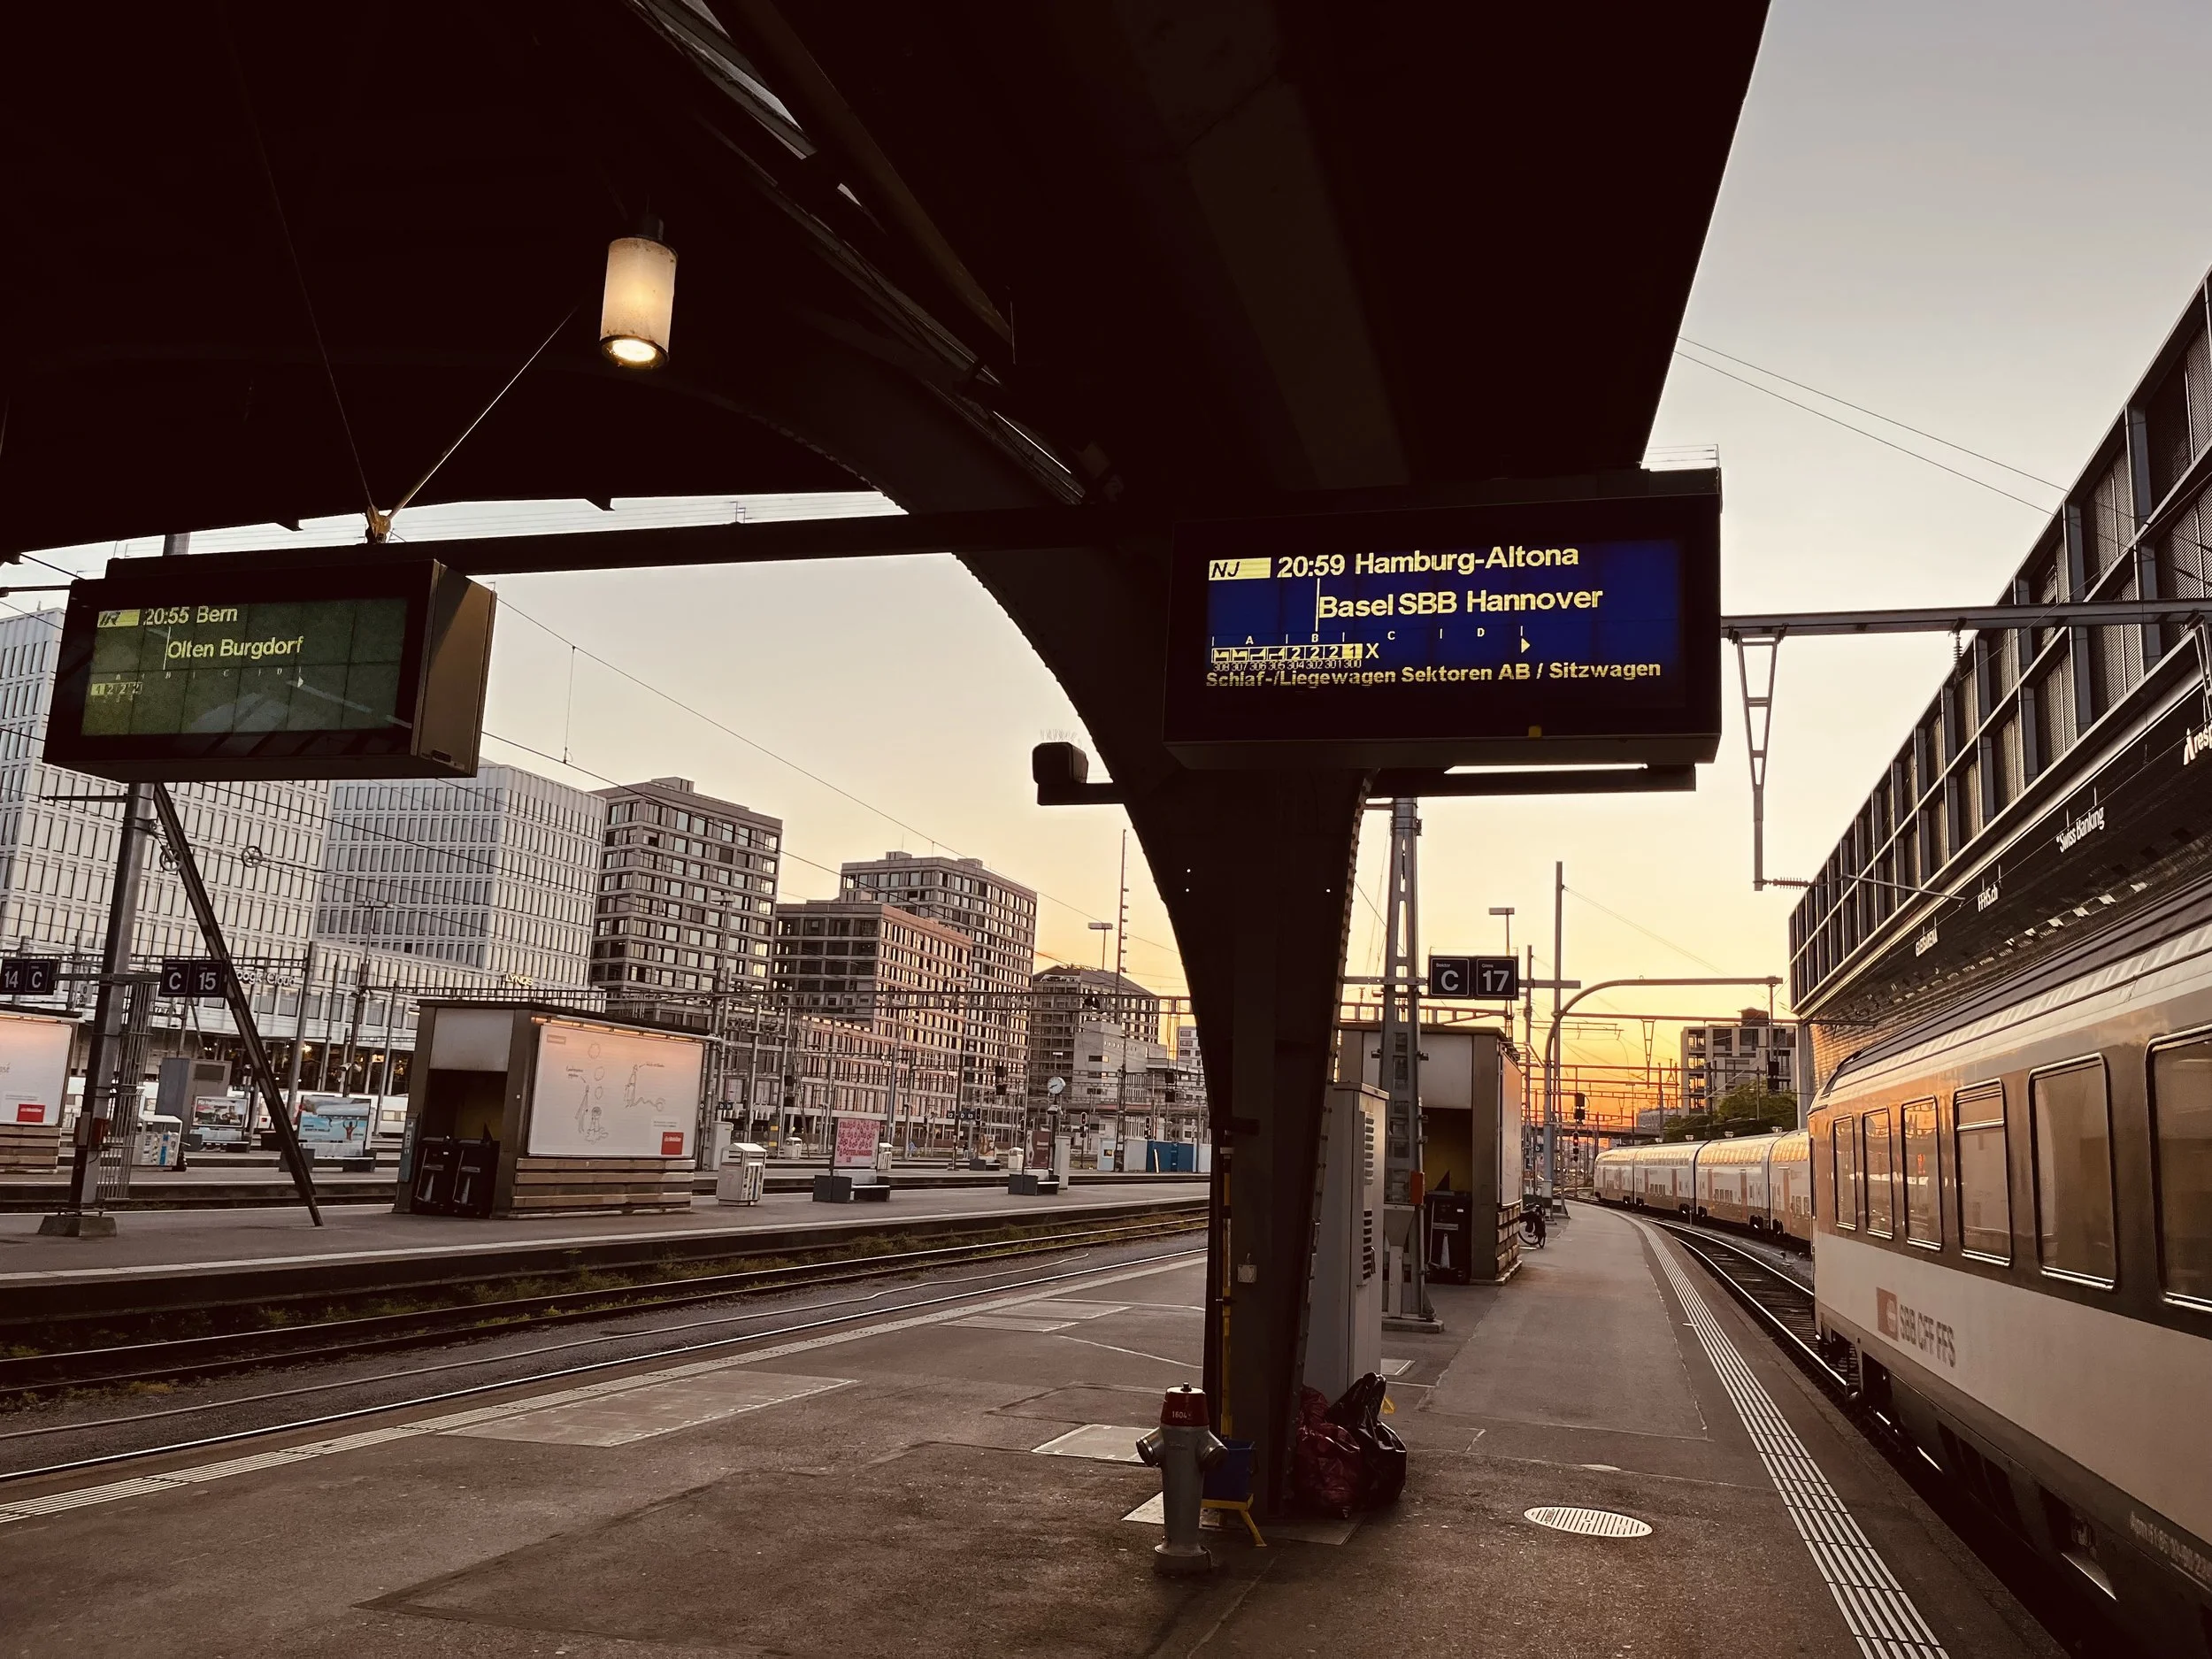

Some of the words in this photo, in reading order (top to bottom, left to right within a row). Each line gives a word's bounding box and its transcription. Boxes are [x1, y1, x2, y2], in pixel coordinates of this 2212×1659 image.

[1211, 562, 1240, 578] NJ
[1277, 554, 1346, 578] 20:59
[1356, 546, 1578, 575] Hamburg-Altona
[1319, 594, 1394, 618] Basel
[1398, 591, 1457, 615] SBB
[1467, 589, 1603, 612] Hannover
[142, 606, 189, 626] 20:55
[196, 605, 238, 623] Bern
[1245, 635, 1254, 645] A
[1311, 634, 1319, 642] B
[1386, 630, 1395, 641] C
[1477, 627, 1485, 637] D
[167, 640, 214, 658] Olten
[219, 635, 304, 660] Burgdorf
[1291, 647, 1301, 660] 2
[1310, 646, 1320, 659] 2
[1328, 645, 1339, 658] 2
[1349, 647, 1356, 657] 1
[1364, 642, 1380, 659] X
[1206, 670, 1395, 688] Schlaf-/Liegewagen
[1401, 665, 1493, 682] Sektoren
[1497, 664, 1531, 680] AB
[1548, 662, 1661, 680] Sitzwagen
[1231, 662, 1247, 671] 307
[1286, 660, 1304, 671] 304
[1305, 660, 1323, 670] 302
[1325, 660, 1341, 669] 301
[2076, 806, 2105, 841] Banking
[4, 970, 19, 988] 14
[31, 971, 42, 988] C
[168, 972, 181, 990] C
[199, 972, 217, 991] 15
[1440, 970, 1459, 991] C
[1482, 970, 1509, 991] 17
[1900, 1303, 1916, 1345] SBB
[1917, 1311, 1934, 1356] CFF
[1936, 1320, 1956, 1368] FFS
